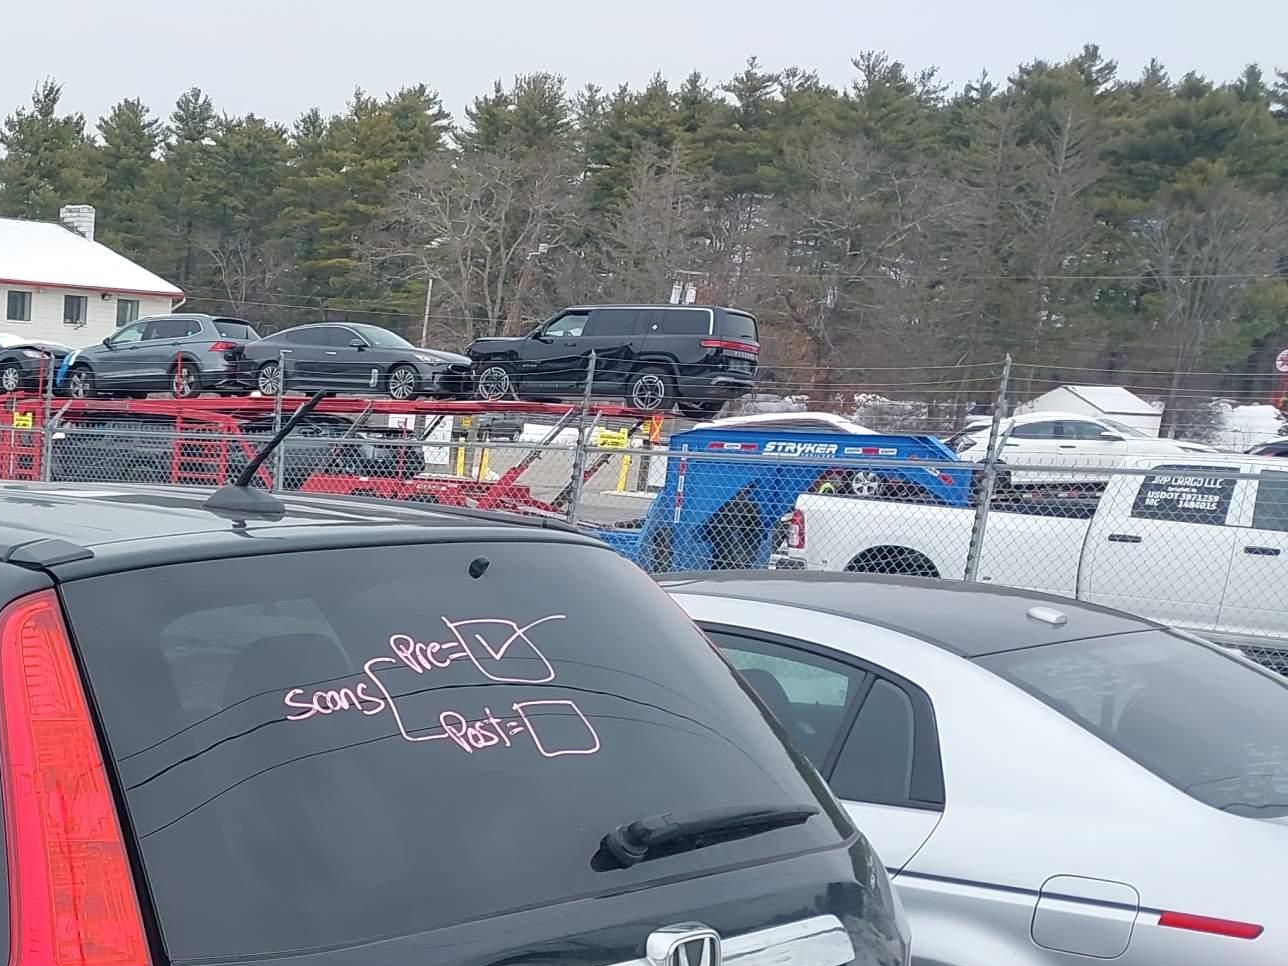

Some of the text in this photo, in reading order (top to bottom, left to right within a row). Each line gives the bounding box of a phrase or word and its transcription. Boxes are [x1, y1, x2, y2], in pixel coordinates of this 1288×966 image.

[762, 441, 838, 457] STRYKER
[1171, 475, 1204, 487] CARGO
[1204, 478, 1225, 489] LLC
[1147, 491, 1179, 500] USDOT
